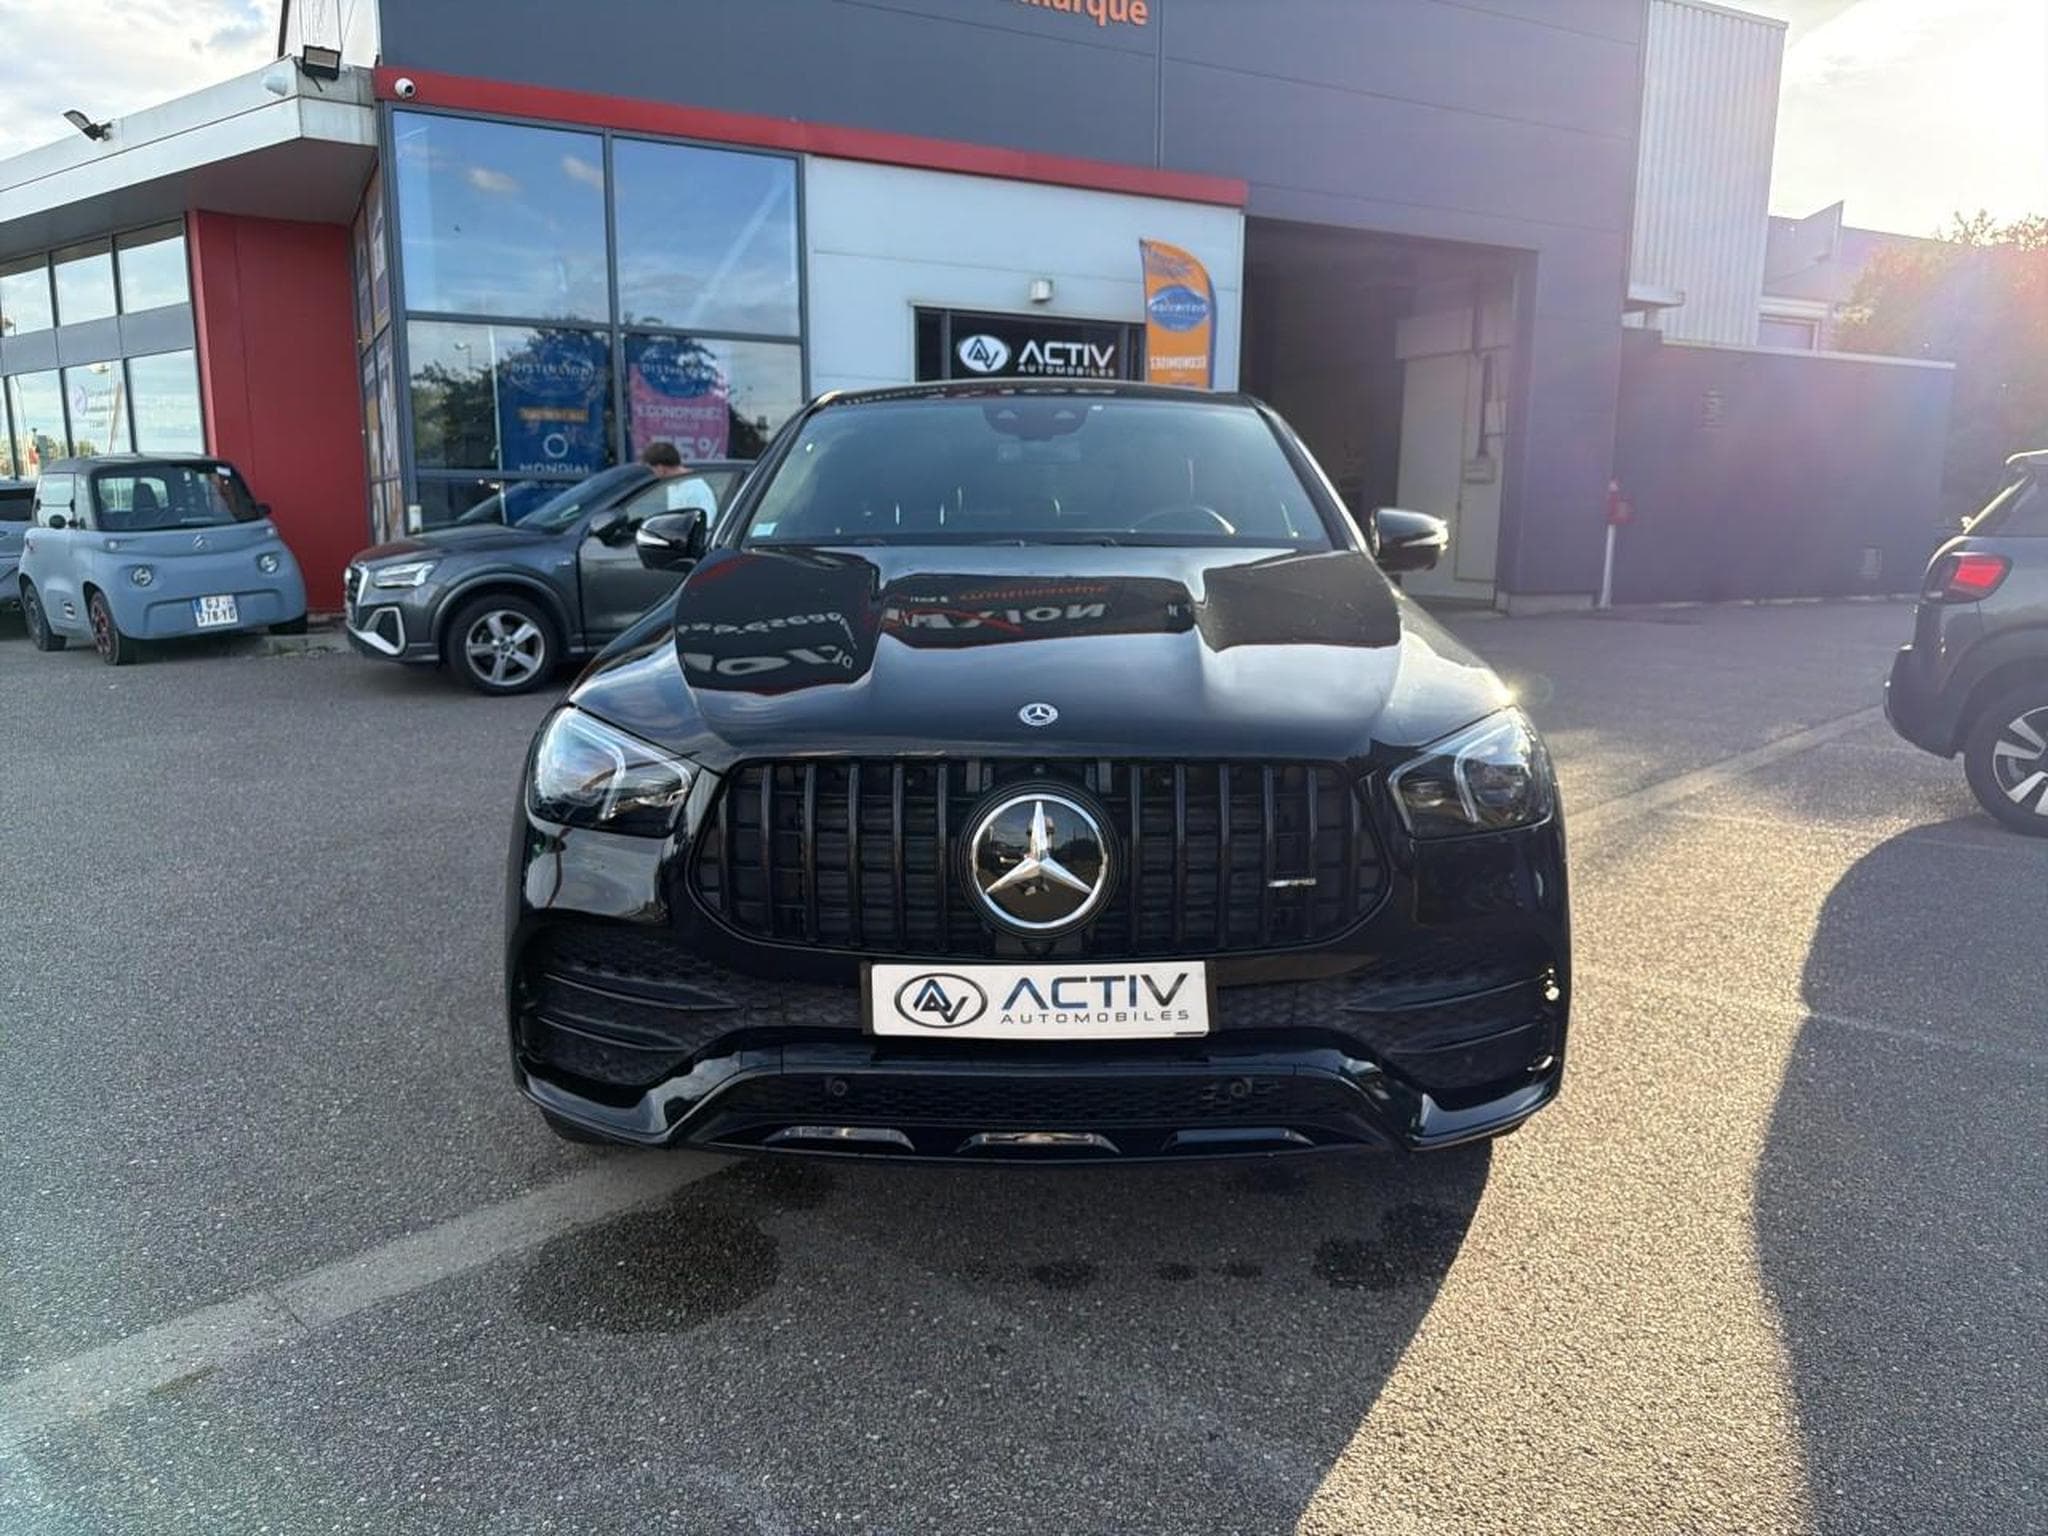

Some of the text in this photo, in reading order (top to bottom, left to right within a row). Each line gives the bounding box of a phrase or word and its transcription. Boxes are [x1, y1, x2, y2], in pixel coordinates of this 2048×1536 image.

[1020, 0, 1148, 27] arque
[1018, 339, 1115, 368] ACTIV
[1017, 364, 1115, 377] AUTOMOBILES
[1001, 972, 1189, 1010] ACTIV
[1000, 1009, 1190, 1025] AUTOMOBILES
